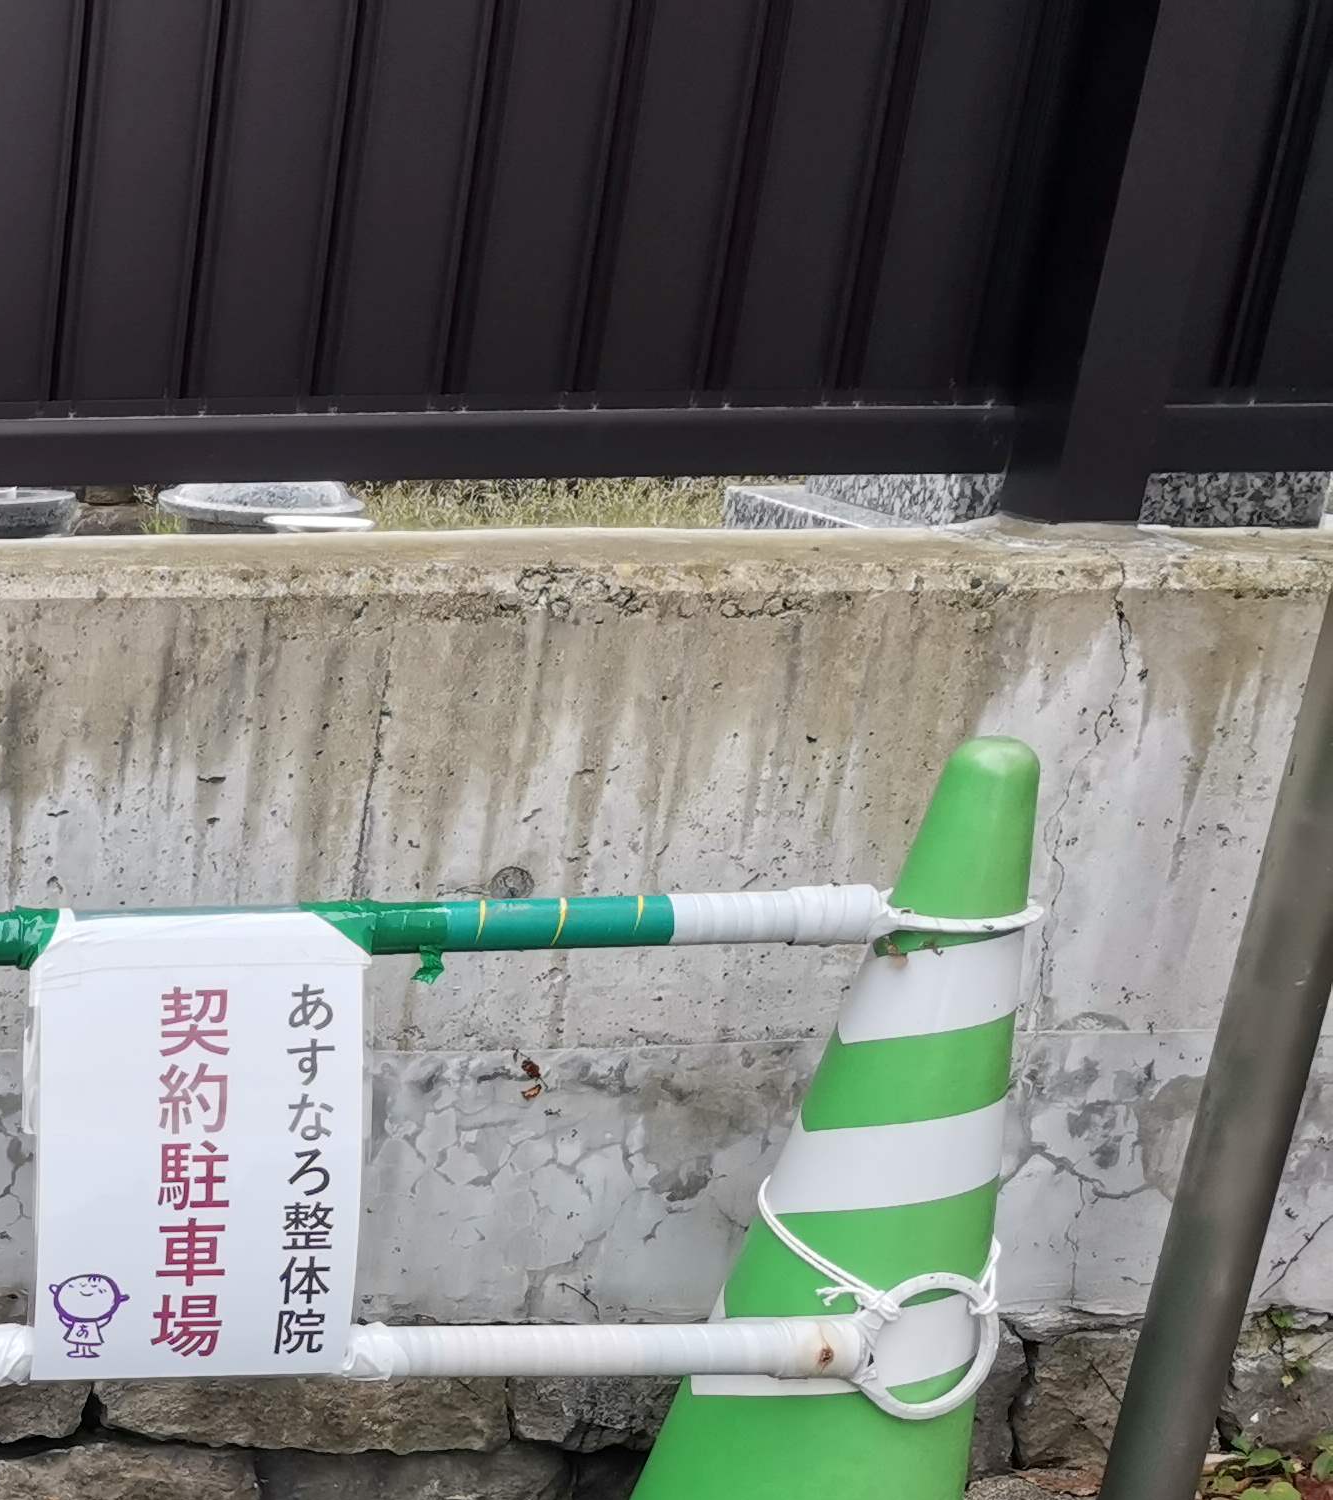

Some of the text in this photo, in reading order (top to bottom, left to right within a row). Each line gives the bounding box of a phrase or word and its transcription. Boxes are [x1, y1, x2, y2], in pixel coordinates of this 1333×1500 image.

[76, 1323, 91, 1339] あ
[150, 986, 230, 1358] 契約駐車場
[274, 983, 336, 1355] あすなろ整体院
